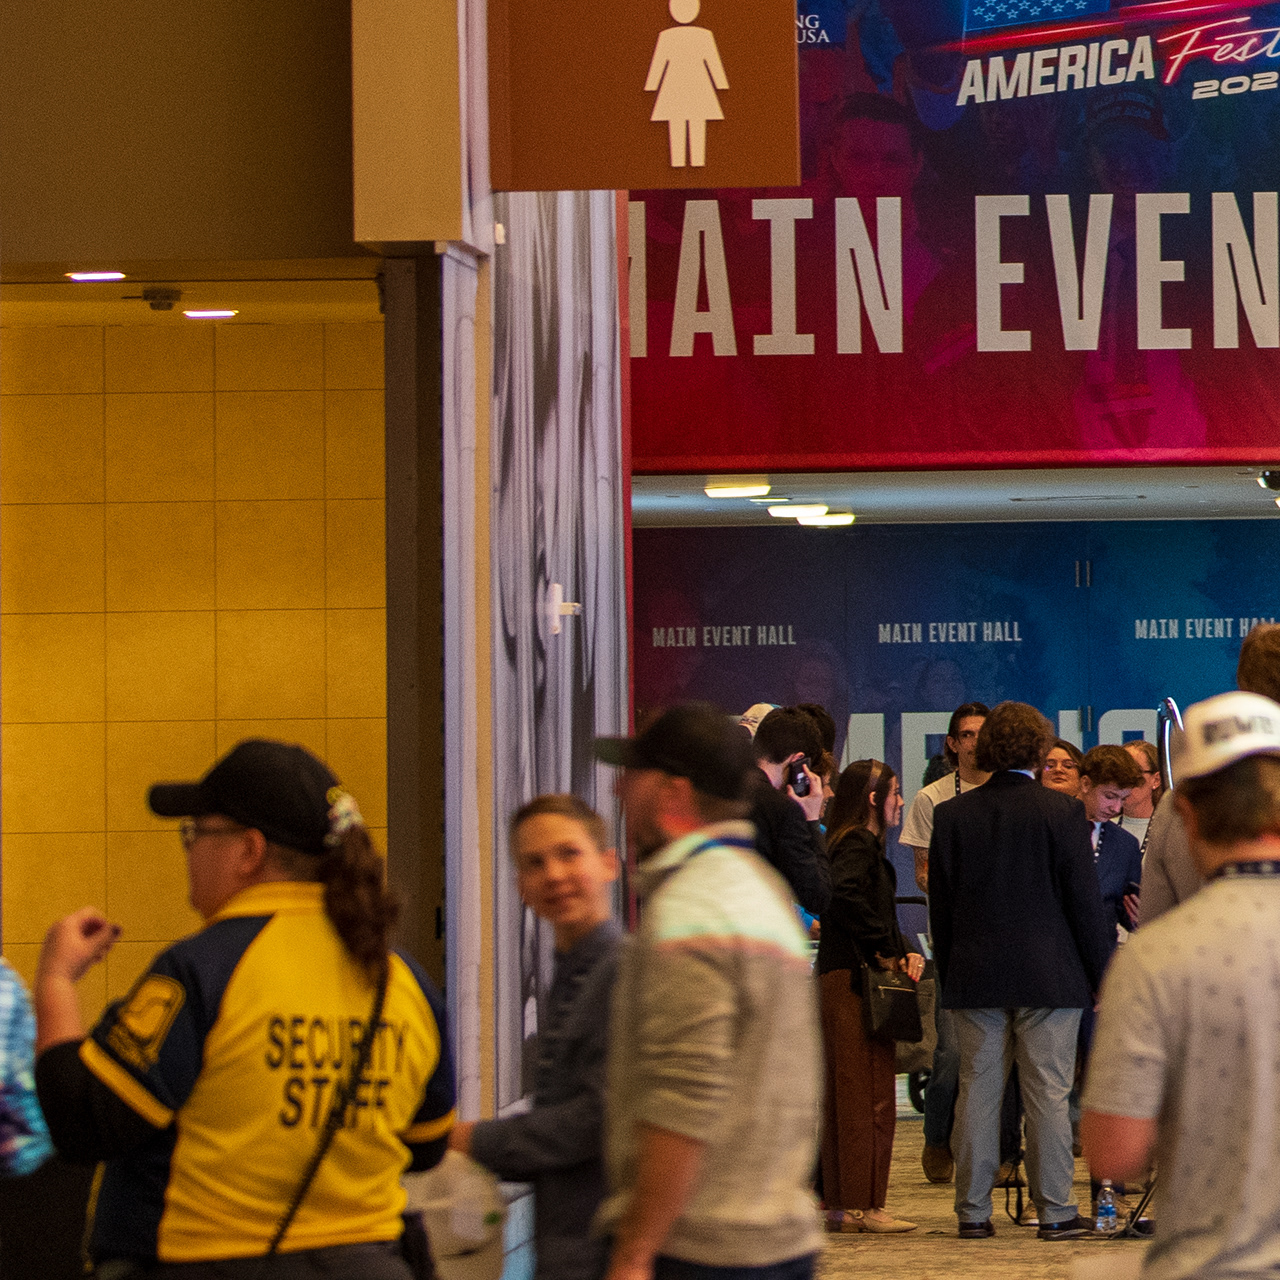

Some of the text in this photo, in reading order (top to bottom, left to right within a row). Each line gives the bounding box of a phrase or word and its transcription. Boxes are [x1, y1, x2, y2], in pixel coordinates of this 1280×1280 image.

[955, 35, 1154, 106] AMERICA
[652, 624, 796, 647] MAIN EVENT HALL
[878, 621, 1022, 644] MAIN EVENT HALL
[1135, 619, 1179, 639] MAIN
[1185, 618, 1234, 639] EVENT
[265, 1014, 407, 1072] SECURTY
